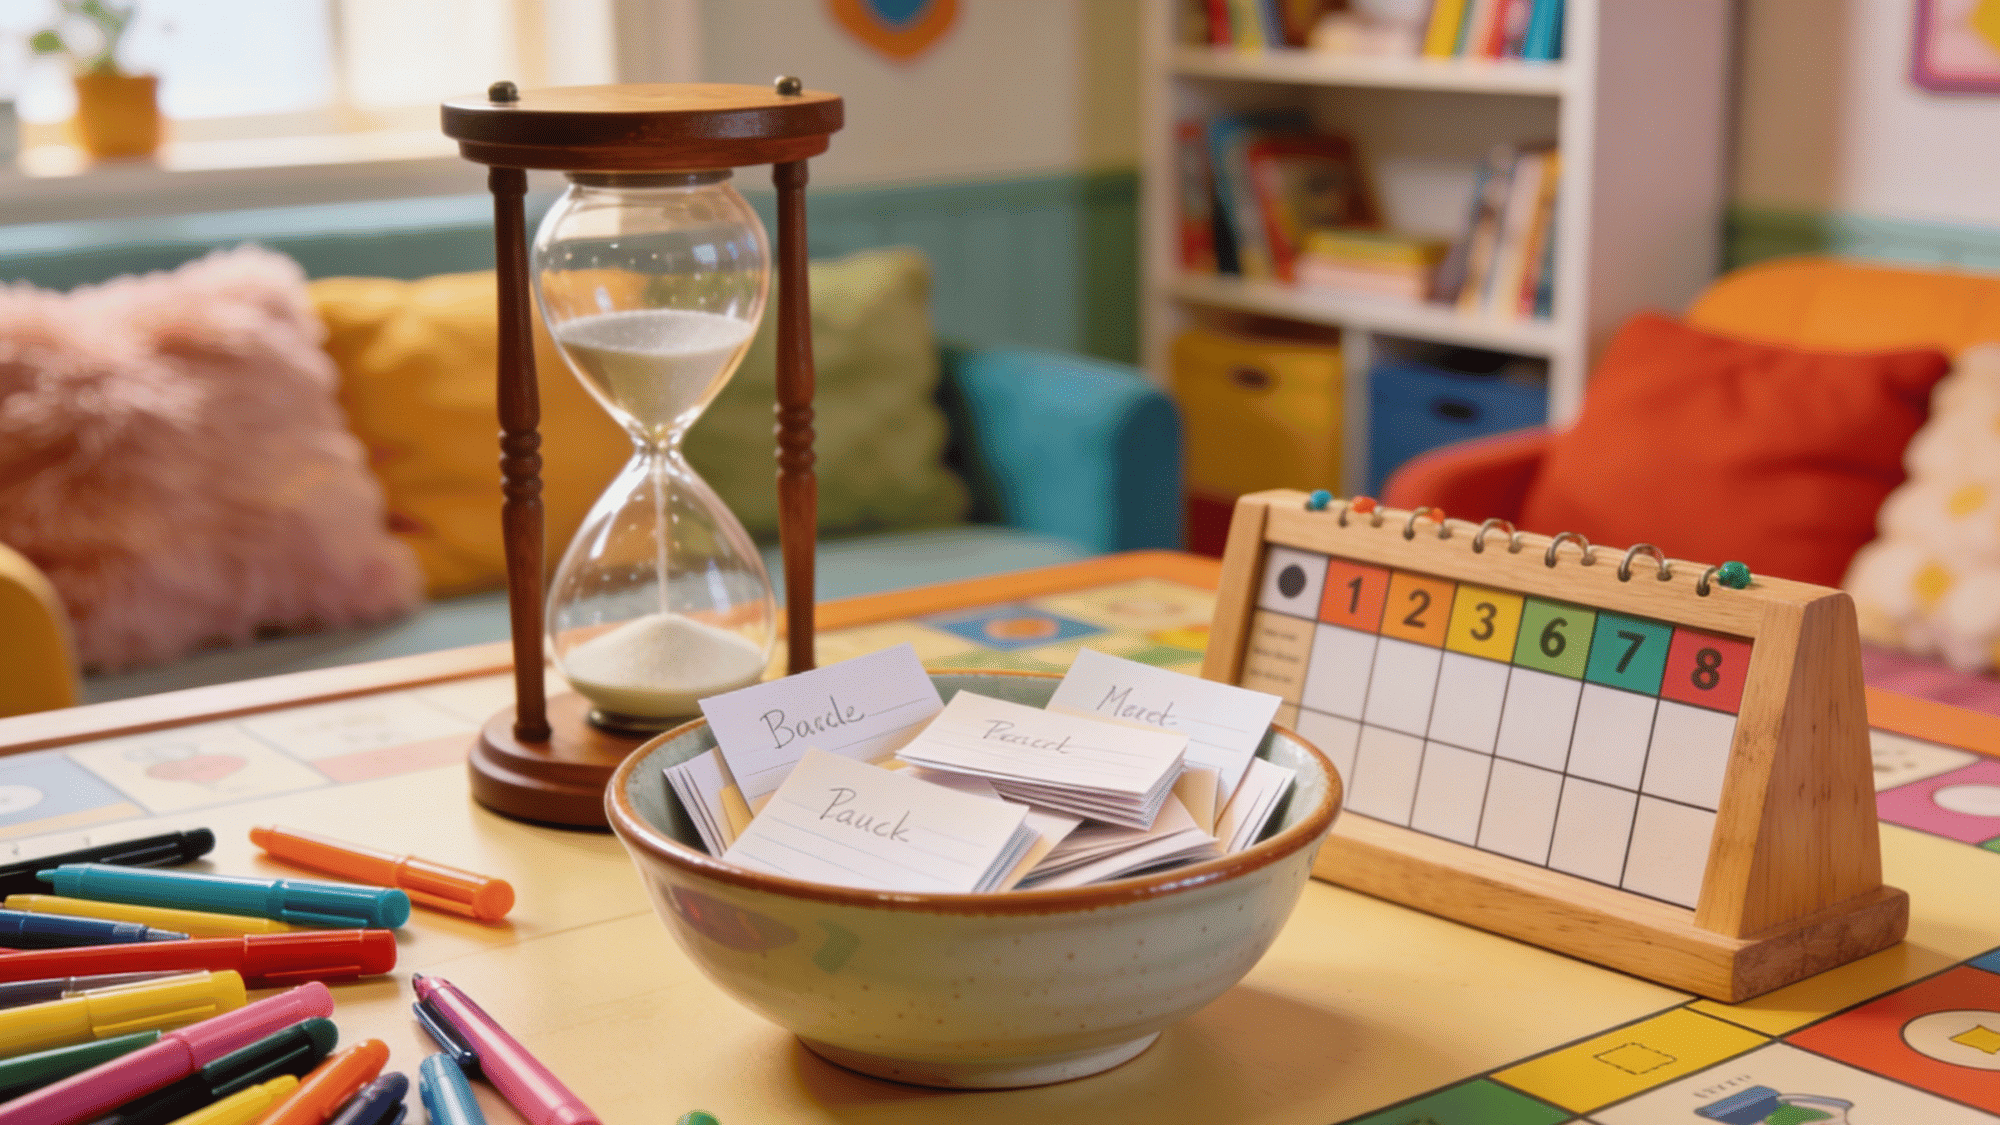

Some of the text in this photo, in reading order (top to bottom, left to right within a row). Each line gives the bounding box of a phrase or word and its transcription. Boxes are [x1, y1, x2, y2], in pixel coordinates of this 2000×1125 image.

[1346, 576, 1723, 690] 1 2 3 6 7 8
